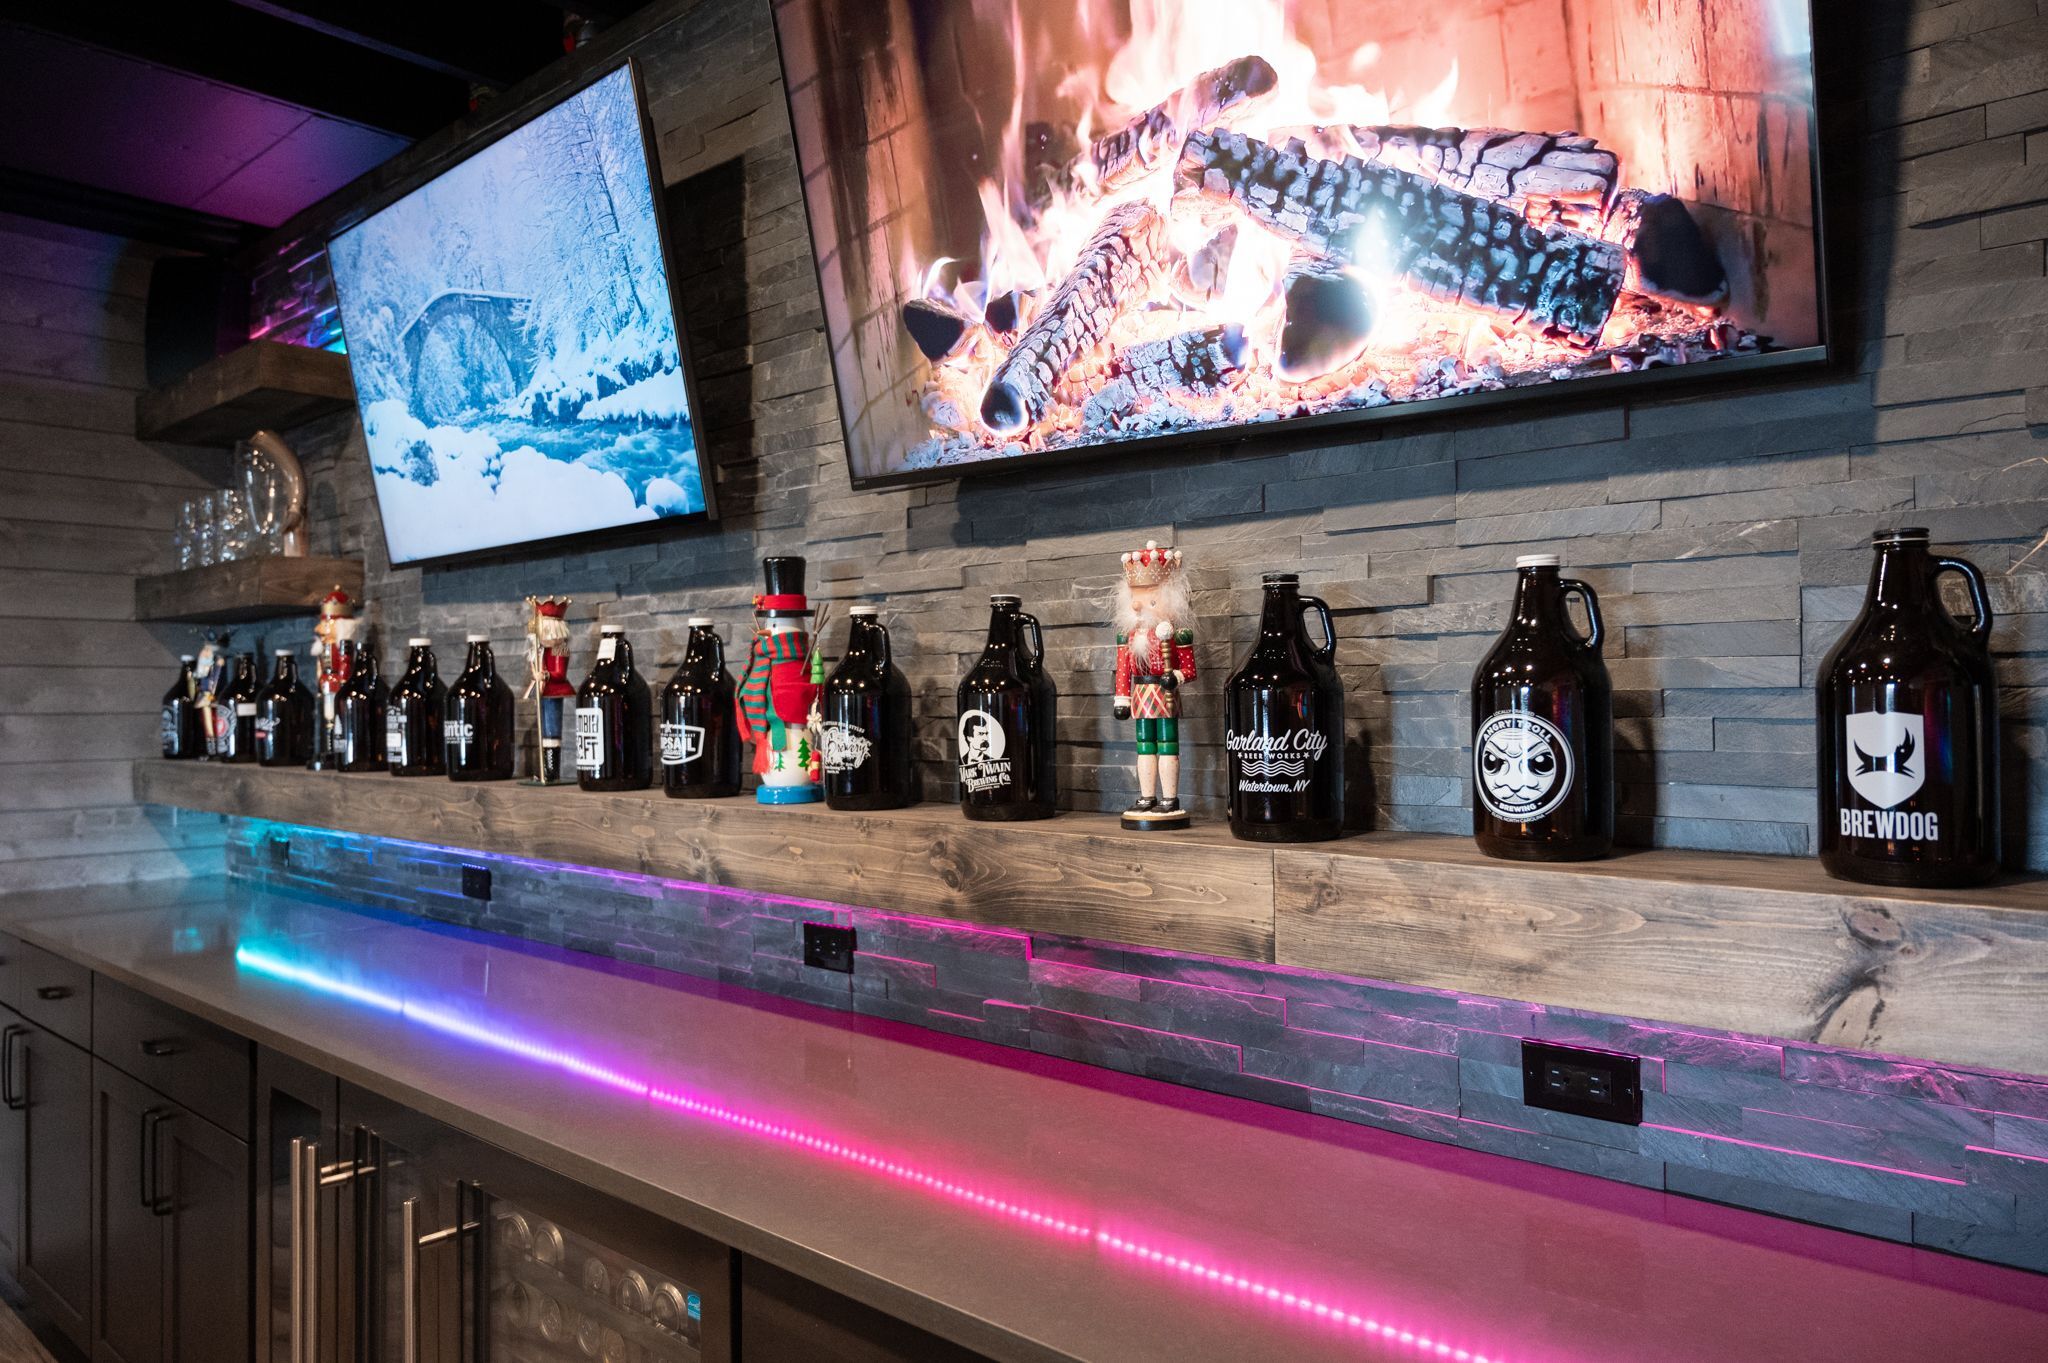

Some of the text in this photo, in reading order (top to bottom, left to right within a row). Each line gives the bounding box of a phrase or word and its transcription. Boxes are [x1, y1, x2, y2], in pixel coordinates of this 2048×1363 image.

[1483, 719, 1553, 743] ANGRY TROLL
[1226, 728, 1328, 761] Garland City
[1244, 752, 1301, 760] BEER WORKS
[959, 761, 1011, 783] MARK TWAIN
[966, 775, 998, 793] BREWING
[1293, 779, 1311, 792] NY
[1498, 802, 1537, 812] BREWING
[1840, 808, 1939, 841] BREWDOG
